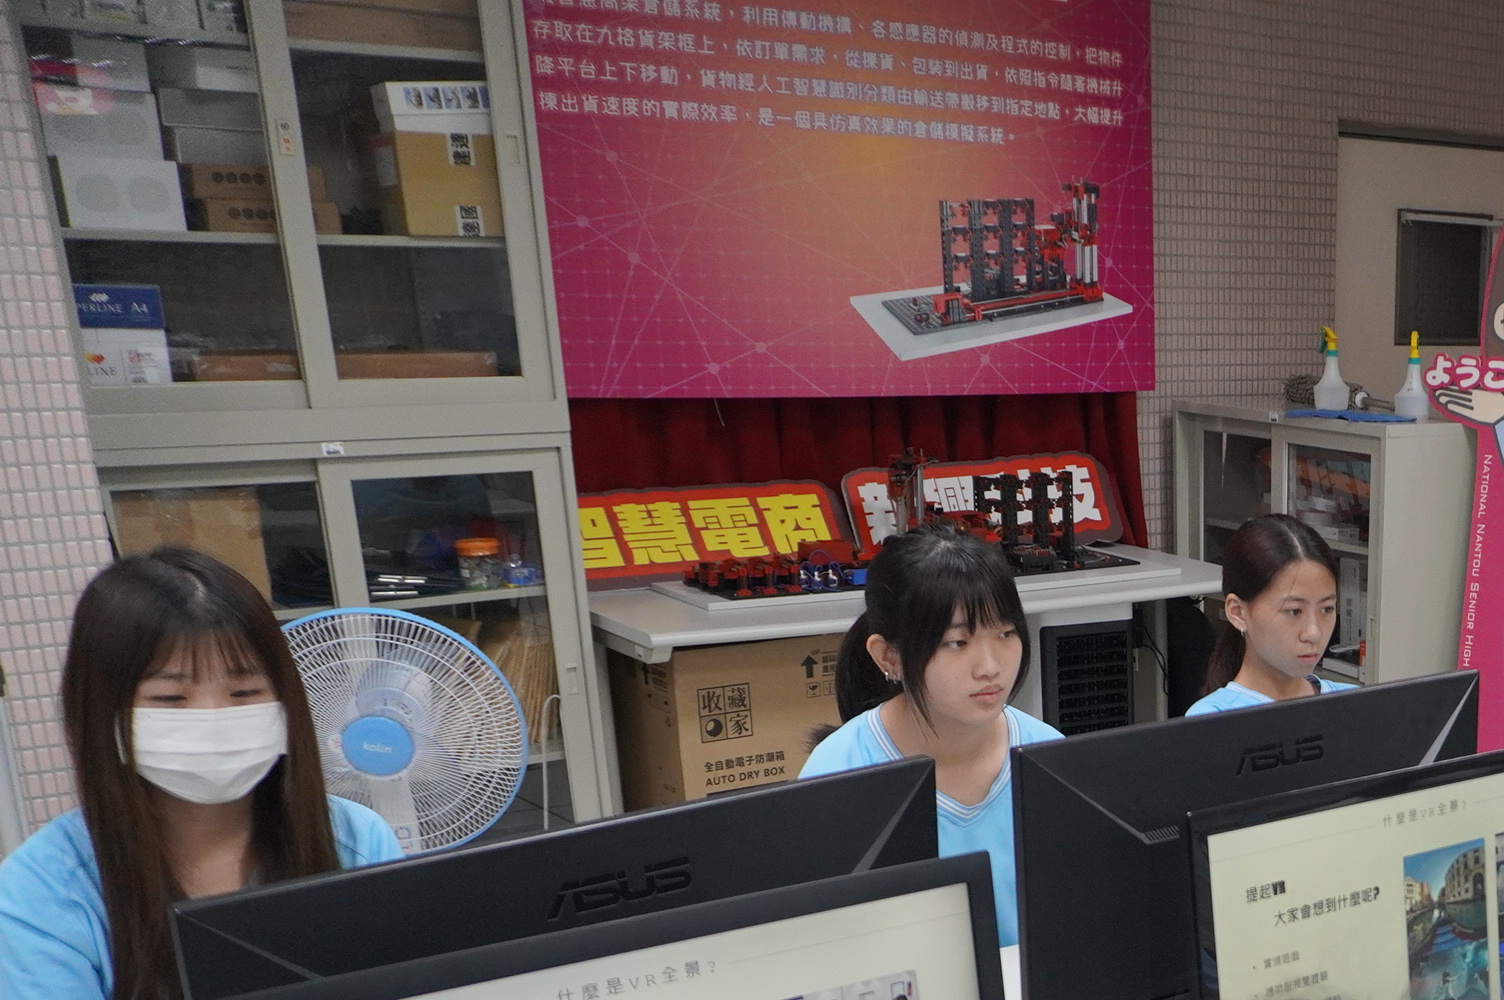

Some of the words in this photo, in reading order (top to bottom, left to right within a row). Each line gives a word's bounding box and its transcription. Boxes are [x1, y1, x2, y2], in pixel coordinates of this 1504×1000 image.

[131, 302, 149, 314] A4
[1477, 454, 1493, 518] NATIONAL
[1472, 524, 1486, 577] NANTOU
[1466, 581, 1480, 630] SENIOR
[1461, 634, 1474, 667] HIGH
[705, 751, 785, 773] 全自動電子防潮箱
[1236, 735, 1324, 776] ASUS
[705, 774, 736, 787] AUTO
[739, 770, 761, 782] DRY
[764, 766, 785, 777] BOX
[548, 855, 692, 922] ASUS
[1245, 880, 1287, 904] 提起VR
[1273, 886, 1380, 927] 大家會想到什麼呢?
